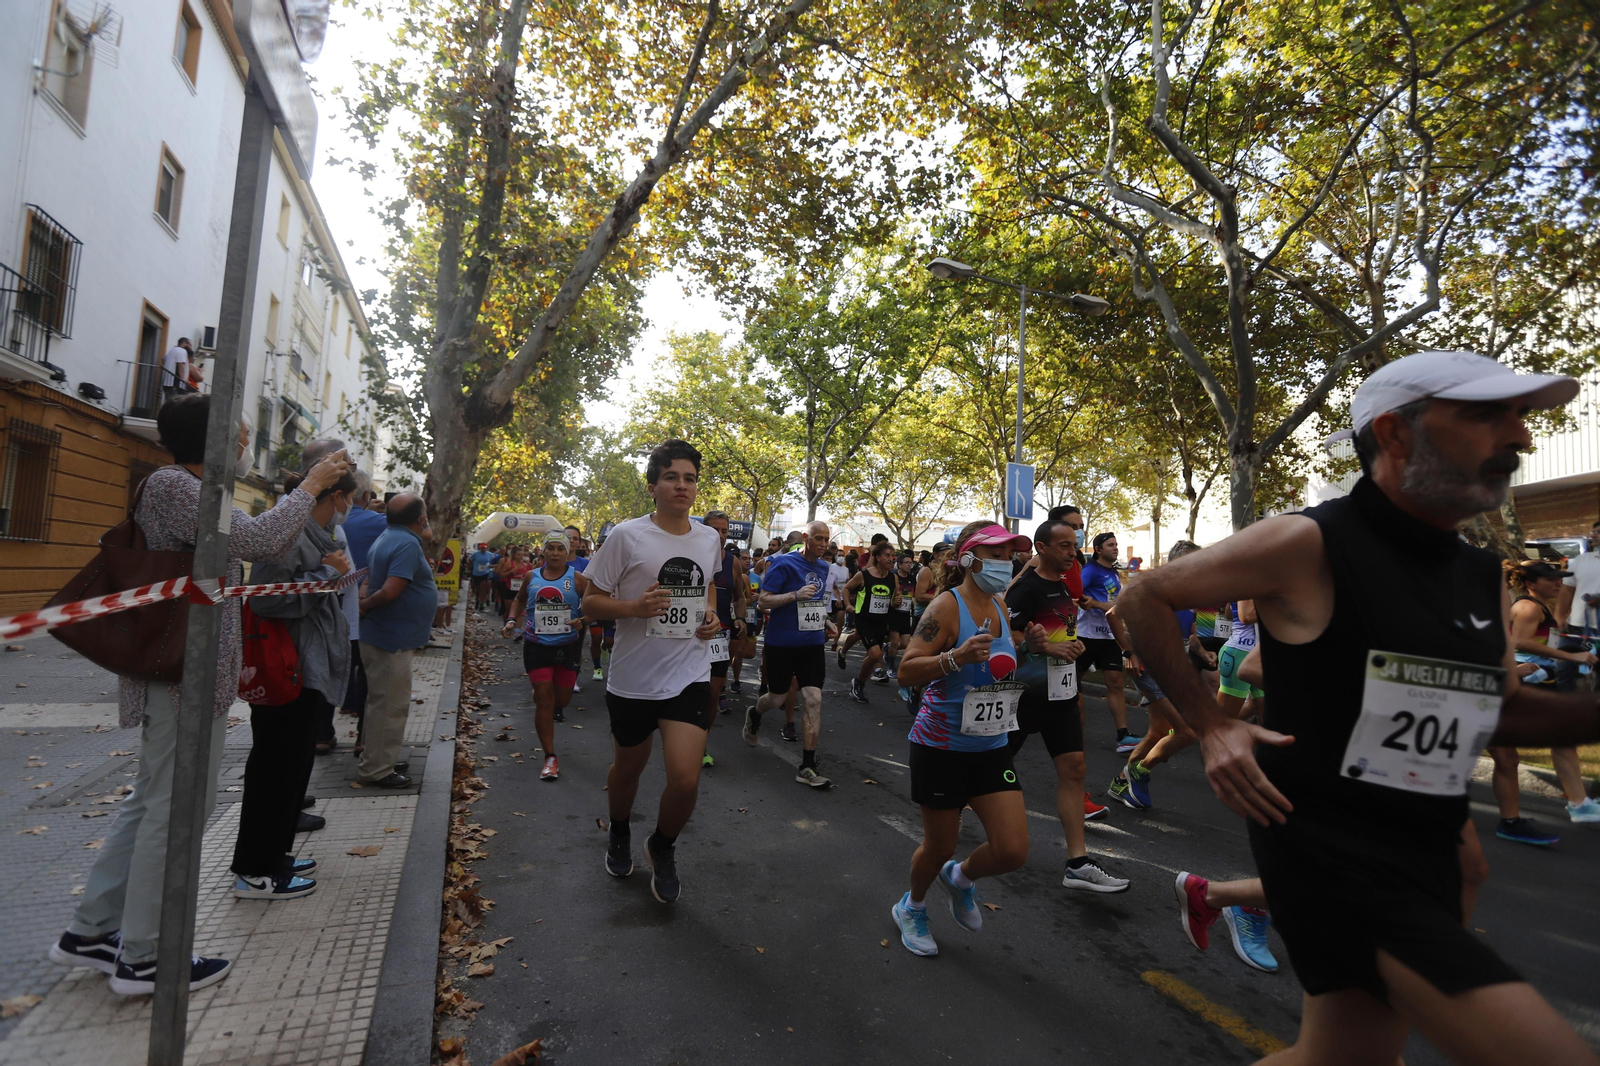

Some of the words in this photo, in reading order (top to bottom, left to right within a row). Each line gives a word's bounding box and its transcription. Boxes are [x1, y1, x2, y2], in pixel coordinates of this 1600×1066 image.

[542, 616, 558, 626] 159
[804, 612, 820, 622] 448
[1220, 624, 1230, 632] 578
[1061, 673, 1072, 688] 47
[1403, 663, 1448, 686] VUELTA
[1450, 670, 1458, 687] A
[1460, 671, 1498, 692] HUELVA
[1407, 688, 1449, 702] GASPAR
[974, 701, 1004, 722] 275
[1381, 710, 1458, 759] 204
